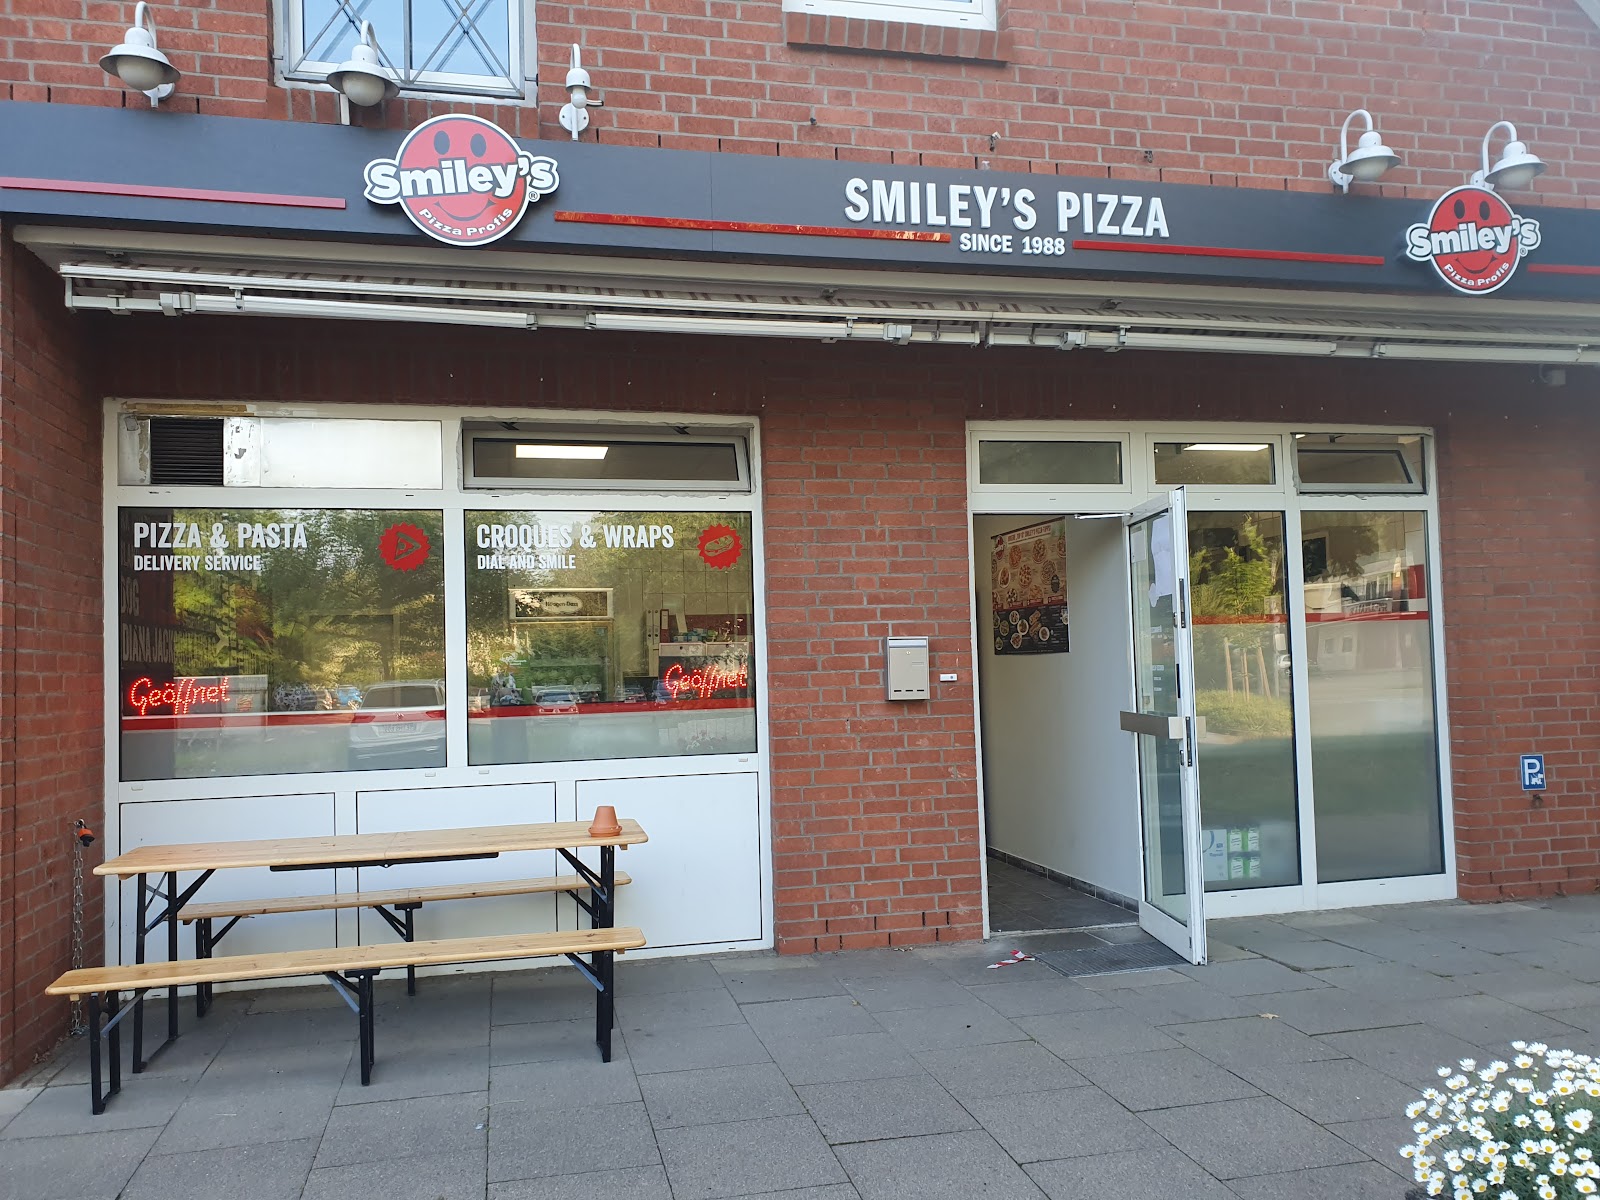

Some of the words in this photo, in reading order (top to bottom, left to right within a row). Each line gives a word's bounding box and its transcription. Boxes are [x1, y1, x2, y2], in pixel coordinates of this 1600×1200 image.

[367, 157, 557, 200] Smiley's
[418, 207, 462, 236] Pizza
[466, 207, 513, 237] Profis
[844, 177, 1038, 232] SMILEY'S
[1057, 190, 1170, 239] PIZZA
[959, 232, 1013, 254] SINCE
[1022, 235, 1066, 256] 1988
[1410, 219, 1537, 256] Smiley's
[1443, 263, 1475, 286] Pizza
[1477, 262, 1510, 287] Profis
[133, 522, 201, 549] PIZZA
[209, 522, 229, 549] &
[238, 522, 308, 549] PASTA
[476, 524, 573, 550] CROQUES
[579, 524, 597, 549] &
[603, 524, 675, 549] WRAPS
[133, 555, 201, 571] DELIVERY
[204, 555, 262, 571] SERVICE
[477, 555, 506, 570] DIAL
[509, 555, 535, 570] AND
[538, 555, 576, 570] SMILE
[664, 663, 748, 699] Geöffnet
[130, 676, 231, 716] Geöffnet
[1524, 758, 1541, 786] P
